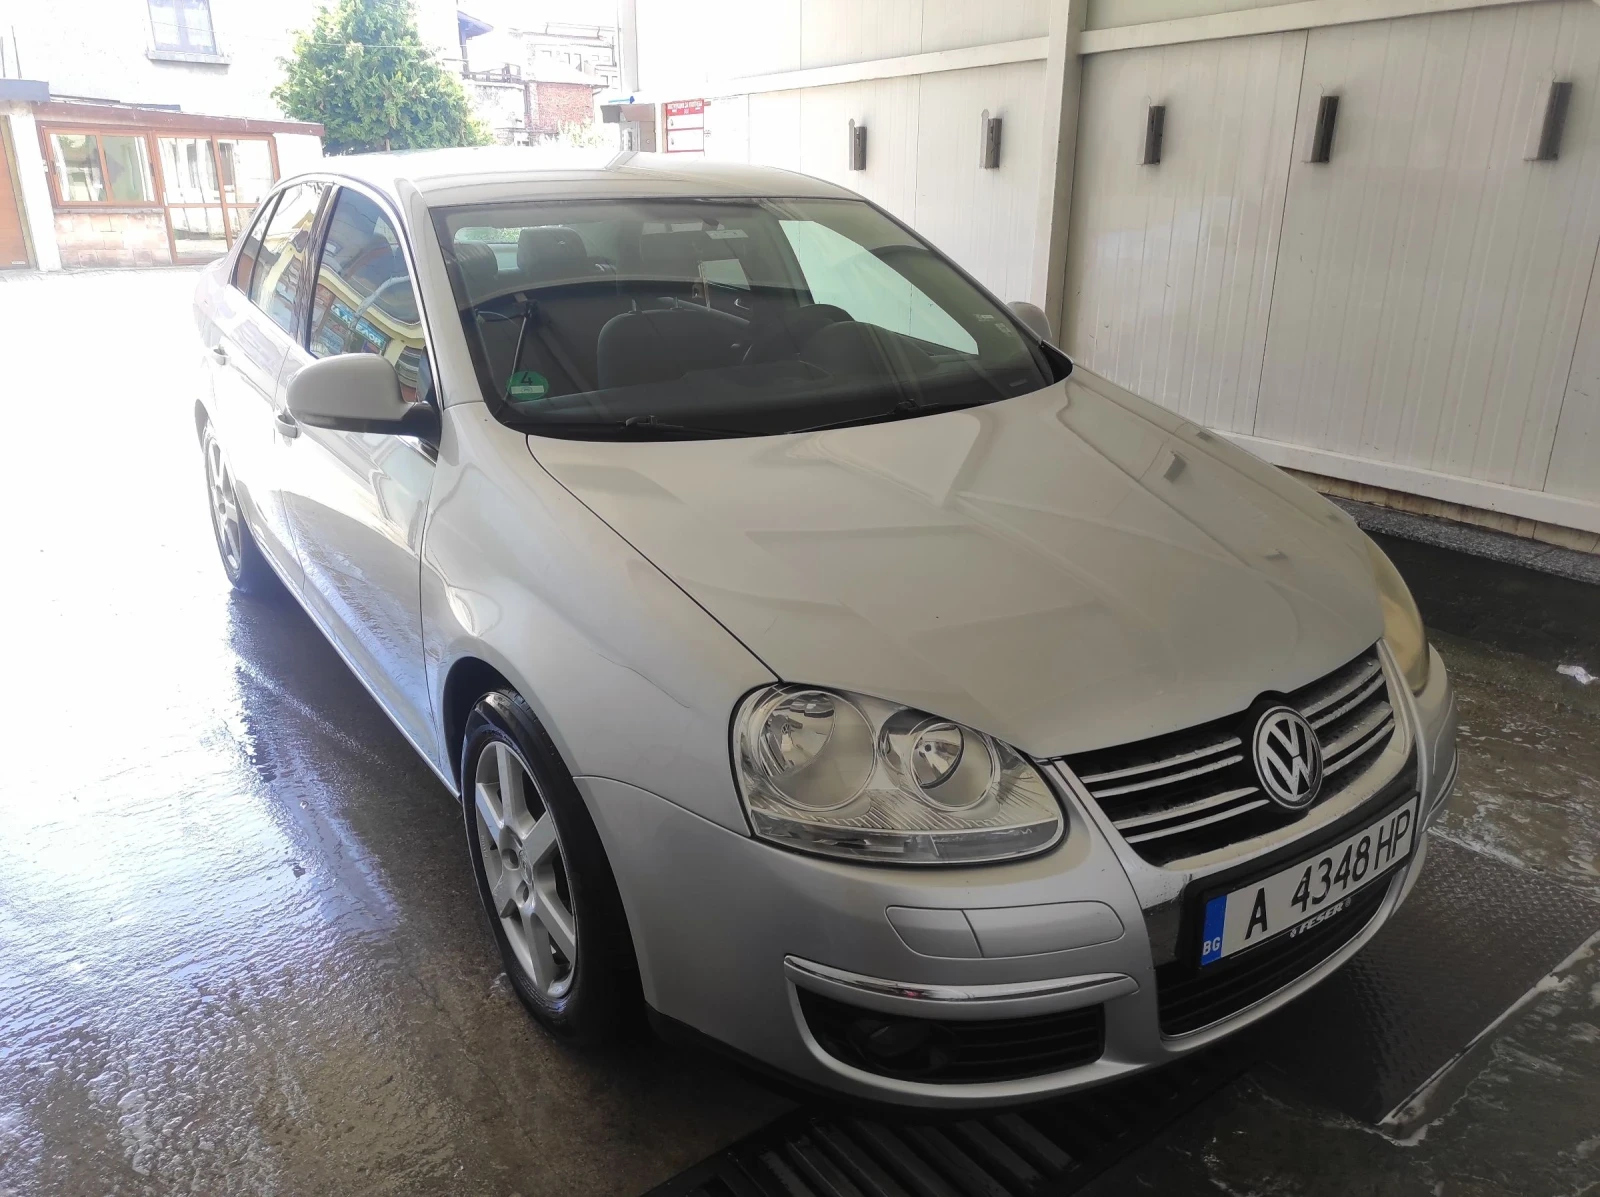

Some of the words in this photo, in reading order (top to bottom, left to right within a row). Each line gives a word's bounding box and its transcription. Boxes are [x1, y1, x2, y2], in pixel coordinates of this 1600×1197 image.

[520, 371, 533, 386] 4
[1245, 887, 1268, 940] A
[1291, 835, 1371, 913] 4348
[1203, 936, 1221, 956] BG
